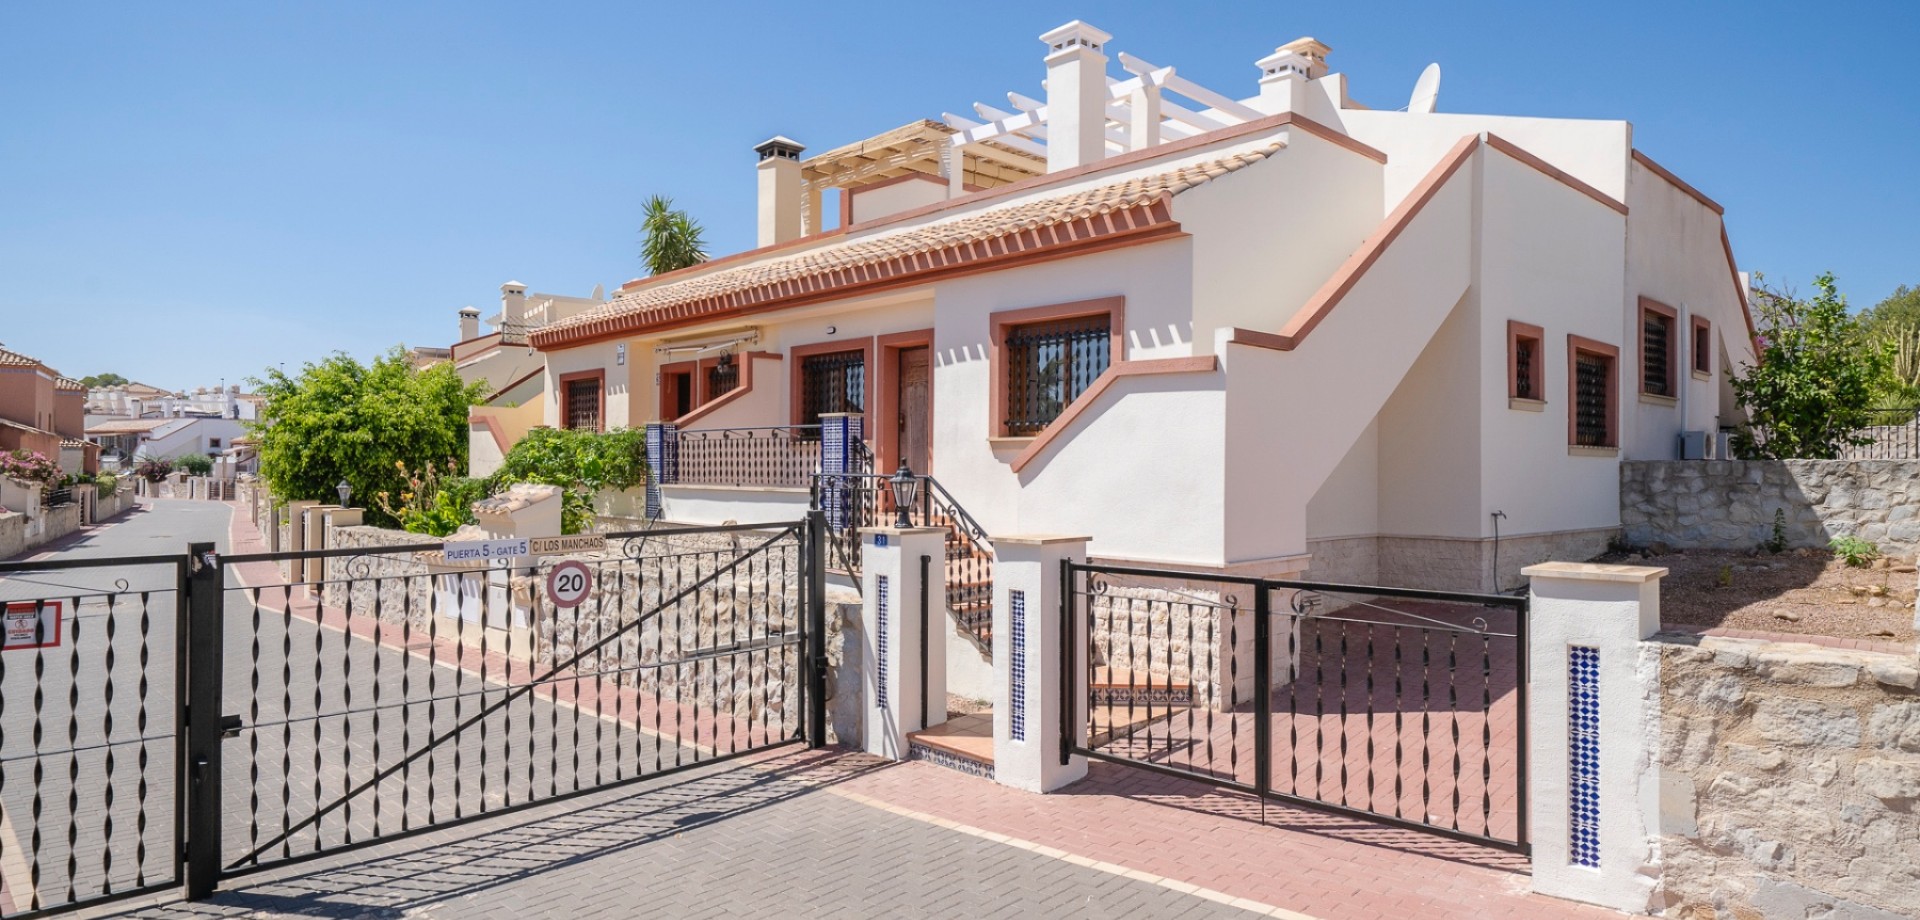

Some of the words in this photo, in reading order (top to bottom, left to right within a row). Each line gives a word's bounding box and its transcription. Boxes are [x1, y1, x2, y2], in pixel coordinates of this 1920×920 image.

[447, 549, 481, 560] PUERTA
[482, 544, 490, 557] 5
[496, 546, 518, 556] GATE
[519, 542, 527, 554] 5
[532, 541, 542, 552] C/
[543, 540, 560, 552] LOS
[561, 537, 604, 550] MANCHAOS
[557, 574, 583, 593] 20
